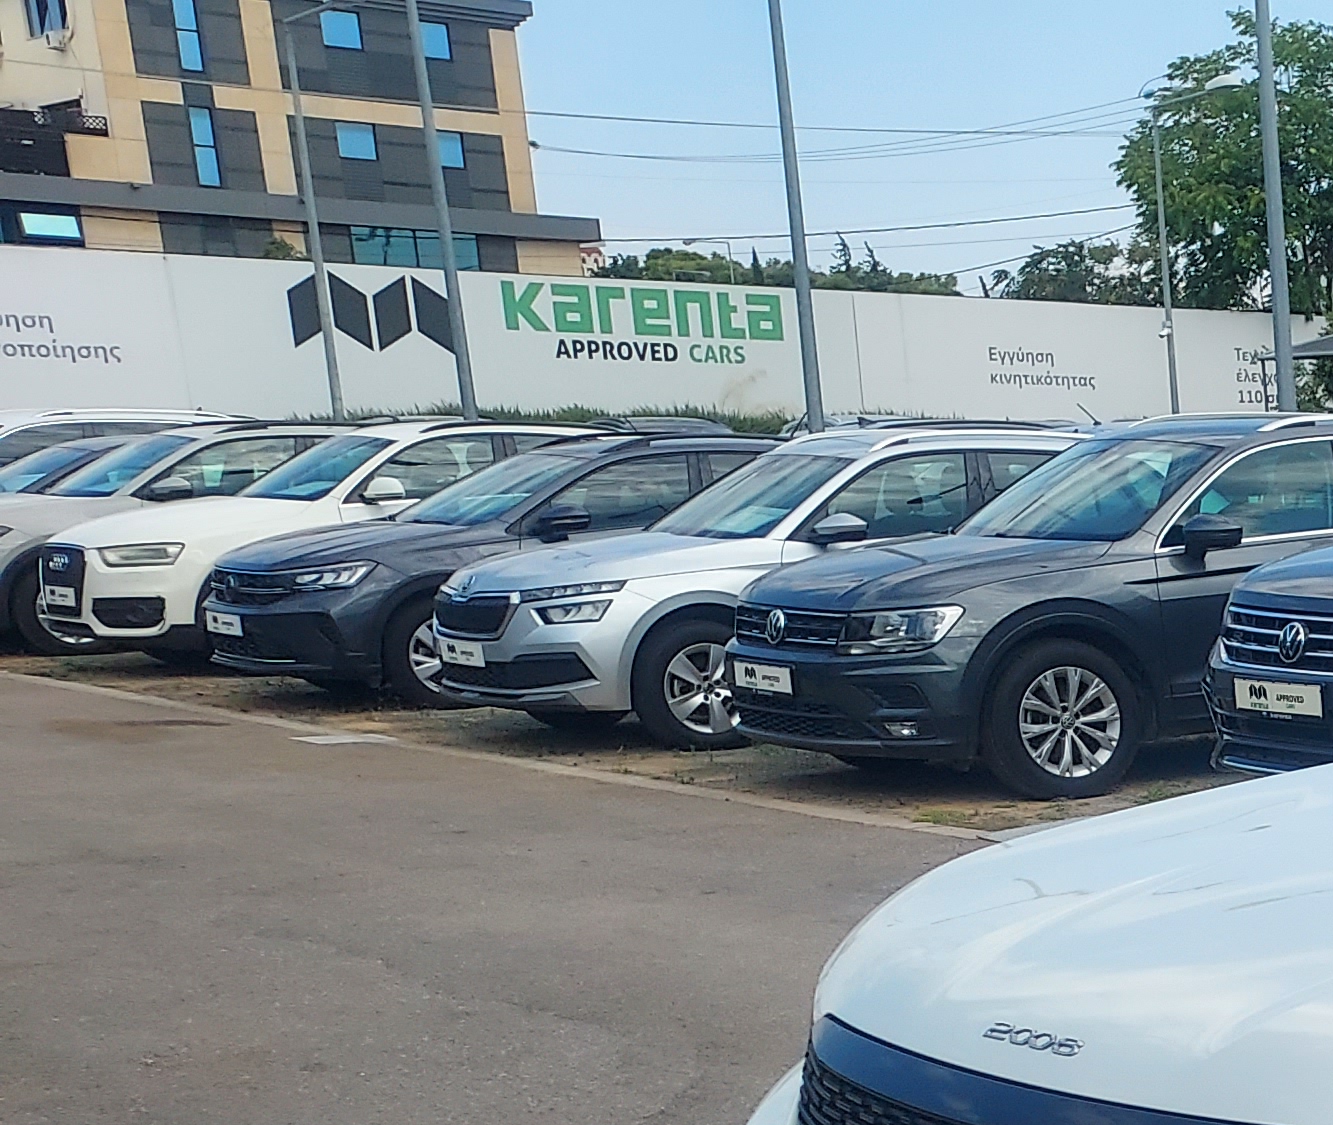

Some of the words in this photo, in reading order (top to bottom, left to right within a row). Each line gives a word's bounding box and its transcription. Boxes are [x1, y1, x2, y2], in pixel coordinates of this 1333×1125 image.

[0, 339, 122, 364] οποίησης
[556, 339, 679, 362] APPROVED
[689, 344, 746, 365] CARS
[988, 346, 1055, 368] Εγγύηση
[990, 370, 1096, 391] κινητικότητας
[1238, 390, 1264, 404] 110
